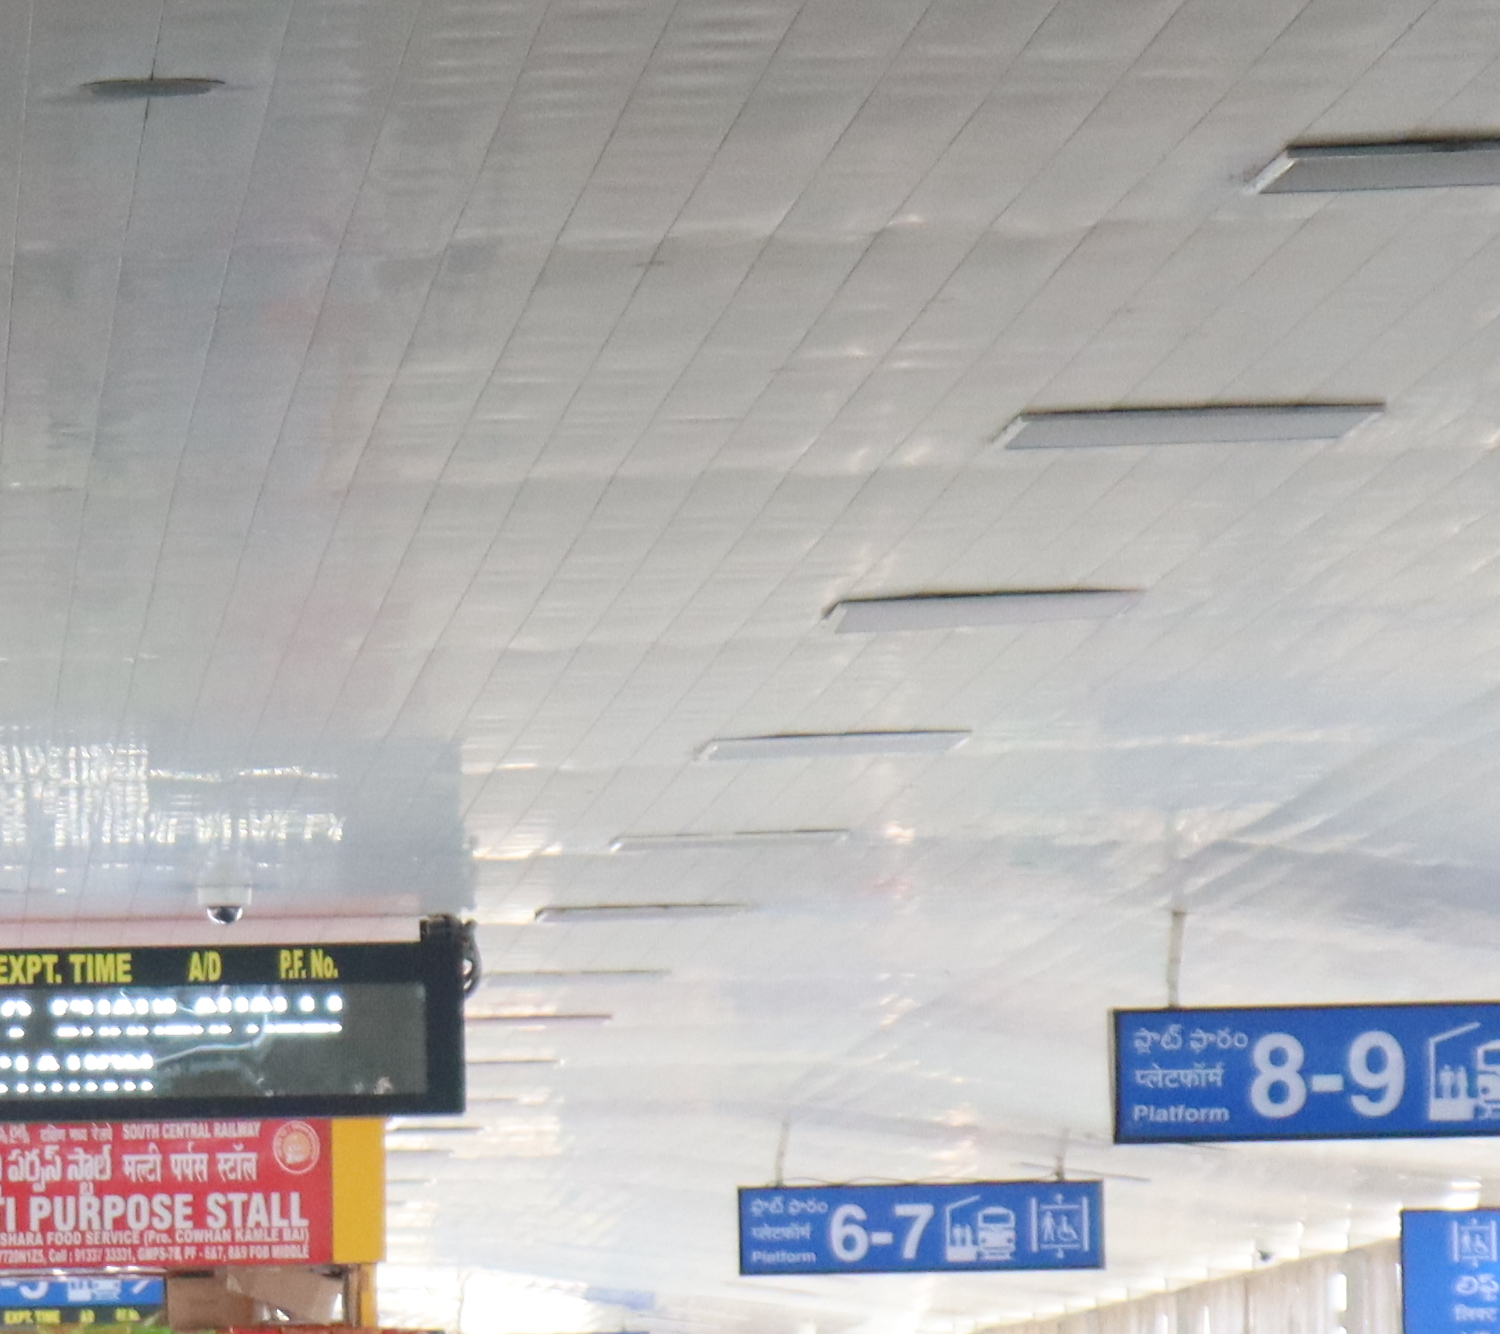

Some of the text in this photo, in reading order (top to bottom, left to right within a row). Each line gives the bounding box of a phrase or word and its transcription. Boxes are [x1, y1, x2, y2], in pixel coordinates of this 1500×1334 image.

[69, 953, 133, 983] TIME
[188, 951, 222, 982] A/D
[280, 949, 338, 979] P.F. No.
[1250, 1030, 1406, 1118] 8-9
[1133, 1104, 1231, 1123] Platform
[122, 1121, 261, 1140] SOUTH CENTRAL RAILWAY
[29, 1193, 194, 1232] PURPOSE
[205, 1191, 310, 1229] STALL
[46, 1231, 82, 1246] FOOD
[85, 1230, 140, 1245] SERVICE
[830, 1203, 935, 1262] 6-7
[752, 1251, 817, 1264] Platform
